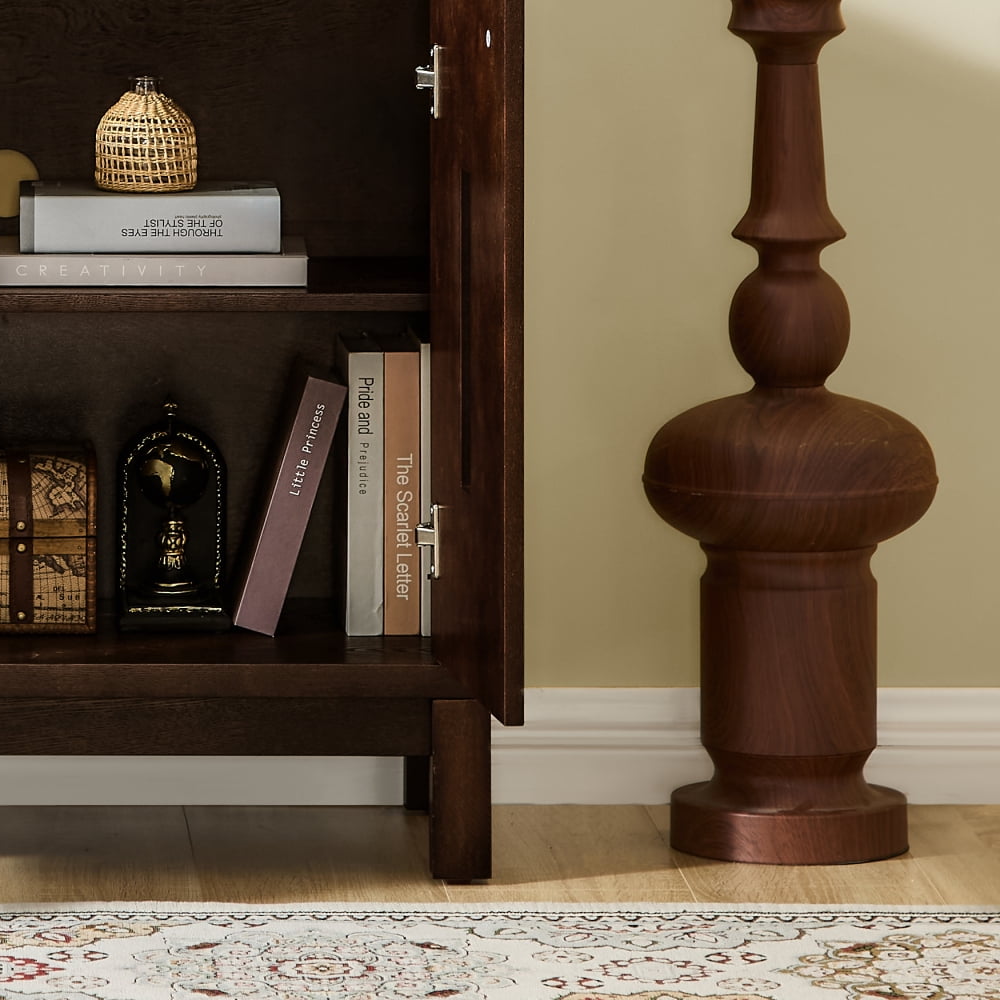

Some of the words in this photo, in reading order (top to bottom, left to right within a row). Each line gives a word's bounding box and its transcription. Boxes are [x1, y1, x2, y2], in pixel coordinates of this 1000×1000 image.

[121, 228, 148, 237] EYES
[143, 219, 185, 228] STYLIST
[150, 228, 171, 237] THE
[172, 228, 224, 237] THROUGH
[186, 219, 207, 228] THE
[209, 219, 224, 228] OF
[15, 263, 207, 277] CREATIVITY
[357, 377, 375, 409] Pride
[357, 411, 375, 435] and
[289, 459, 310, 497] Little
[302, 403, 326, 454] Princess
[358, 442, 370, 496] Prejudice
[396, 452, 414, 486] The
[396, 490, 414, 549] Scarlet
[396, 553, 414, 601] Letter
